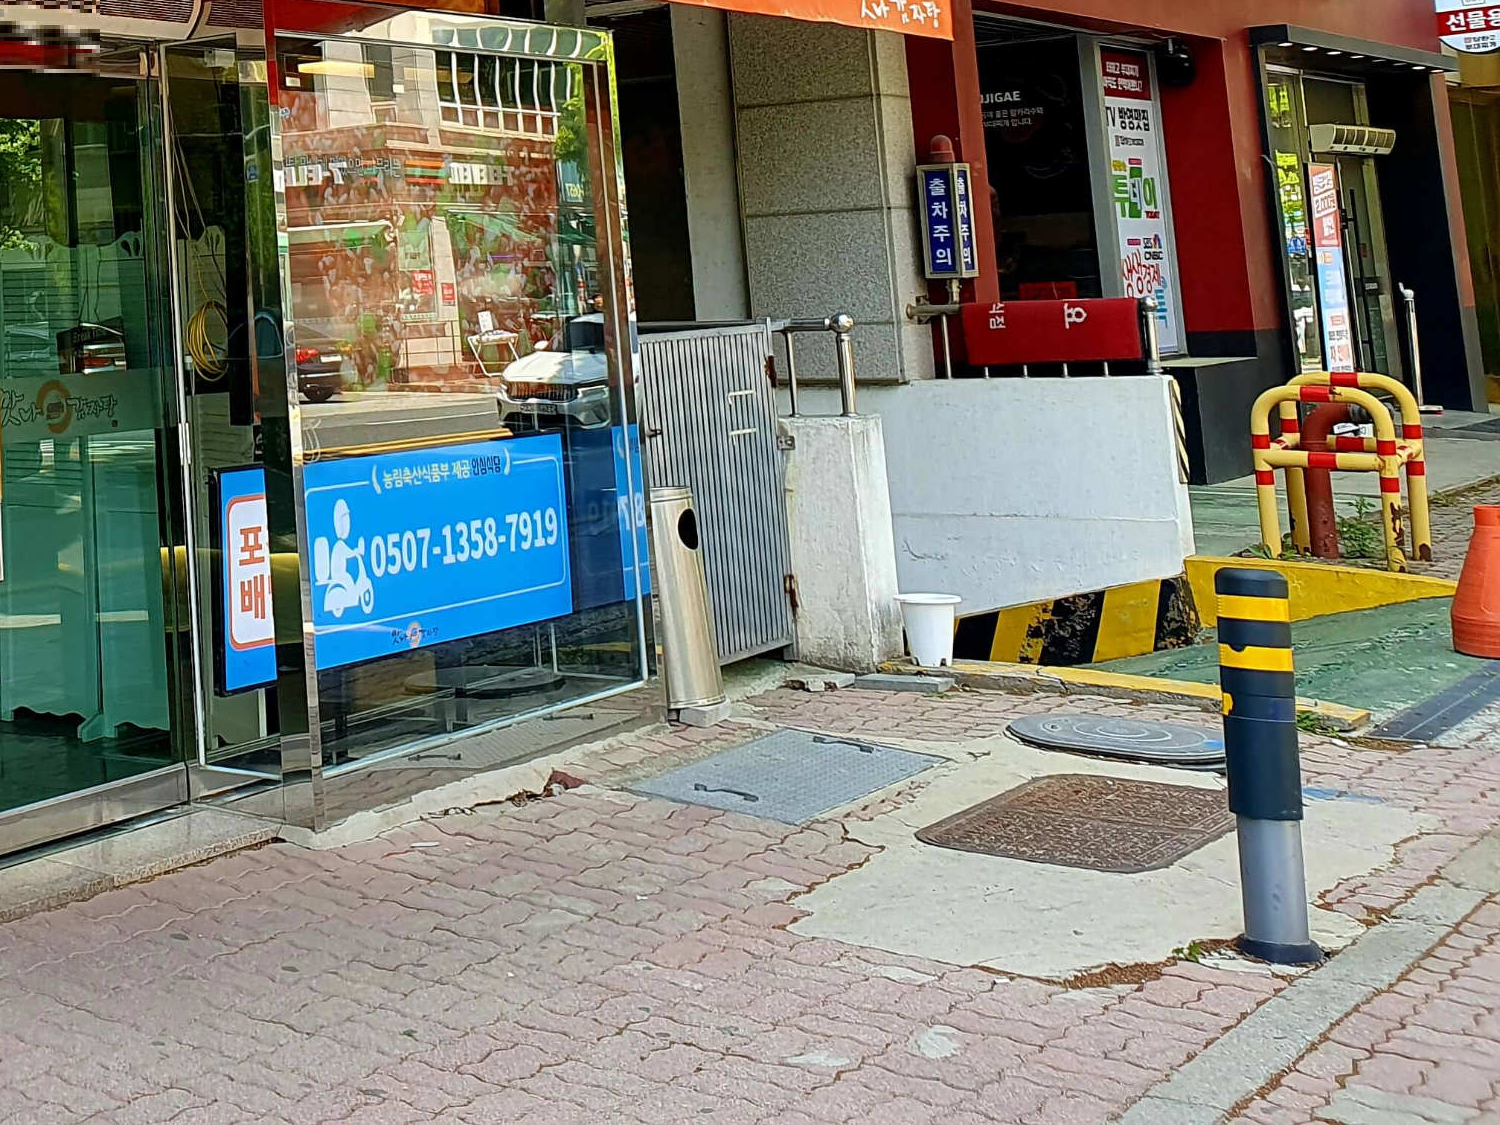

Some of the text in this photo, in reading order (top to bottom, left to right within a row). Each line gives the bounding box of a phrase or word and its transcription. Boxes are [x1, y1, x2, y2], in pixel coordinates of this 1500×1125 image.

[1106, 106, 1150, 131] TV 방영맛집
[928, 178, 952, 266] 출차주의
[957, 177, 972, 265] 출차주의
[383, 461, 450, 489] 농림축산식품부
[452, 459, 470, 479] 제공
[239, 525, 269, 567] 포
[370, 506, 558, 577] 0507-1358-7919
[240, 579, 272, 620] 배
